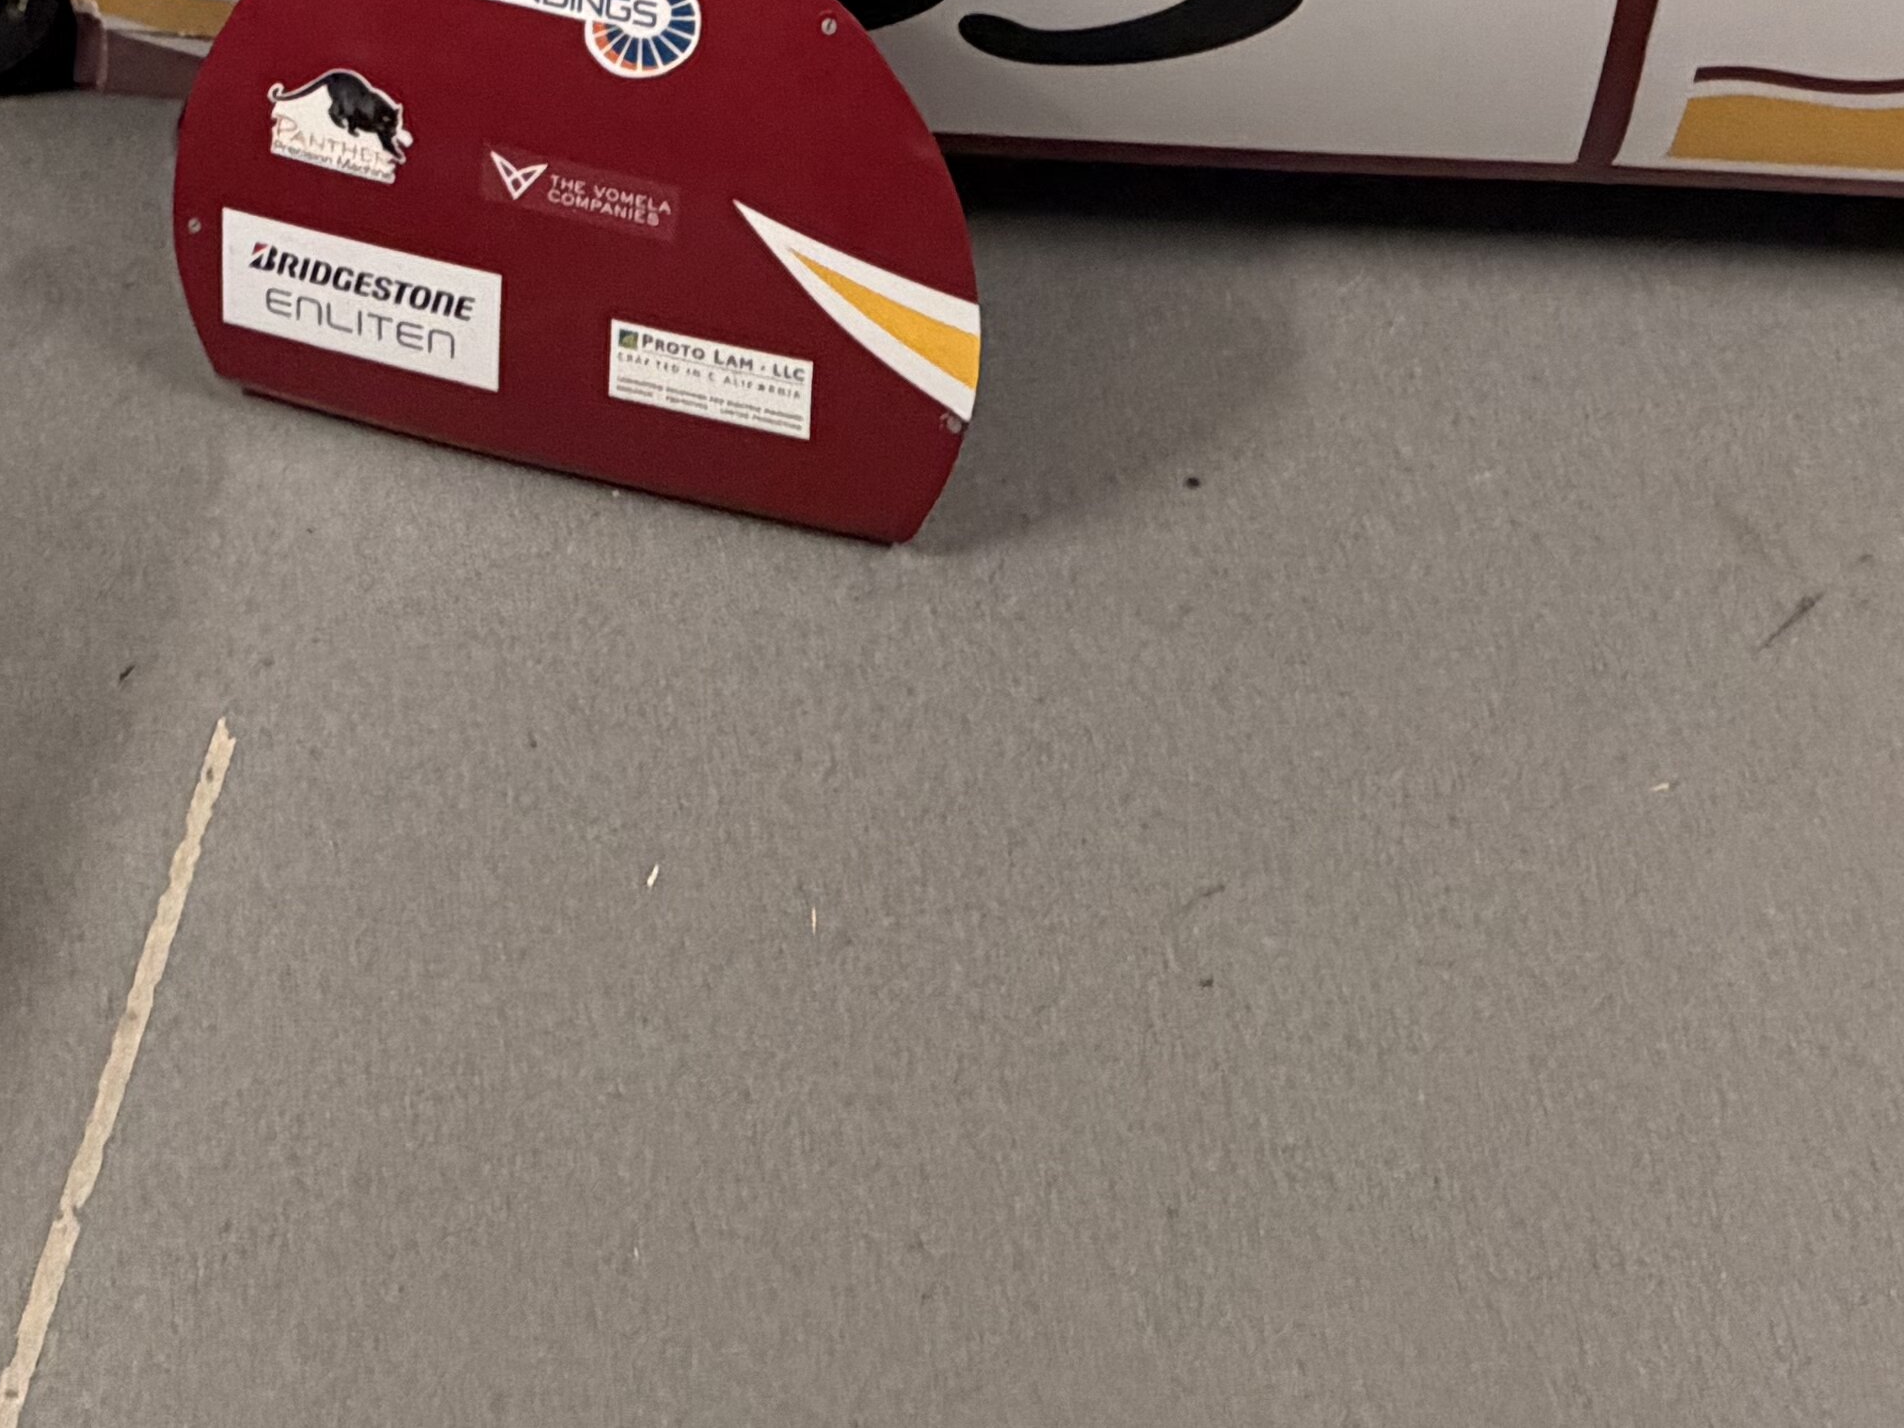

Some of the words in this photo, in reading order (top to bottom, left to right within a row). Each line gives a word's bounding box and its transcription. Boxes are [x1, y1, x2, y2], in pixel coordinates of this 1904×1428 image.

[547, 188, 661, 227] COMPANIES
[549, 173, 586, 195] THE
[593, 183, 673, 216] VOMELA
[248, 241, 476, 322] BRIDGESTONE
[641, 333, 706, 361] PROTO
[713, 348, 754, 372] LAM
[772, 362, 806, 384] LLC
